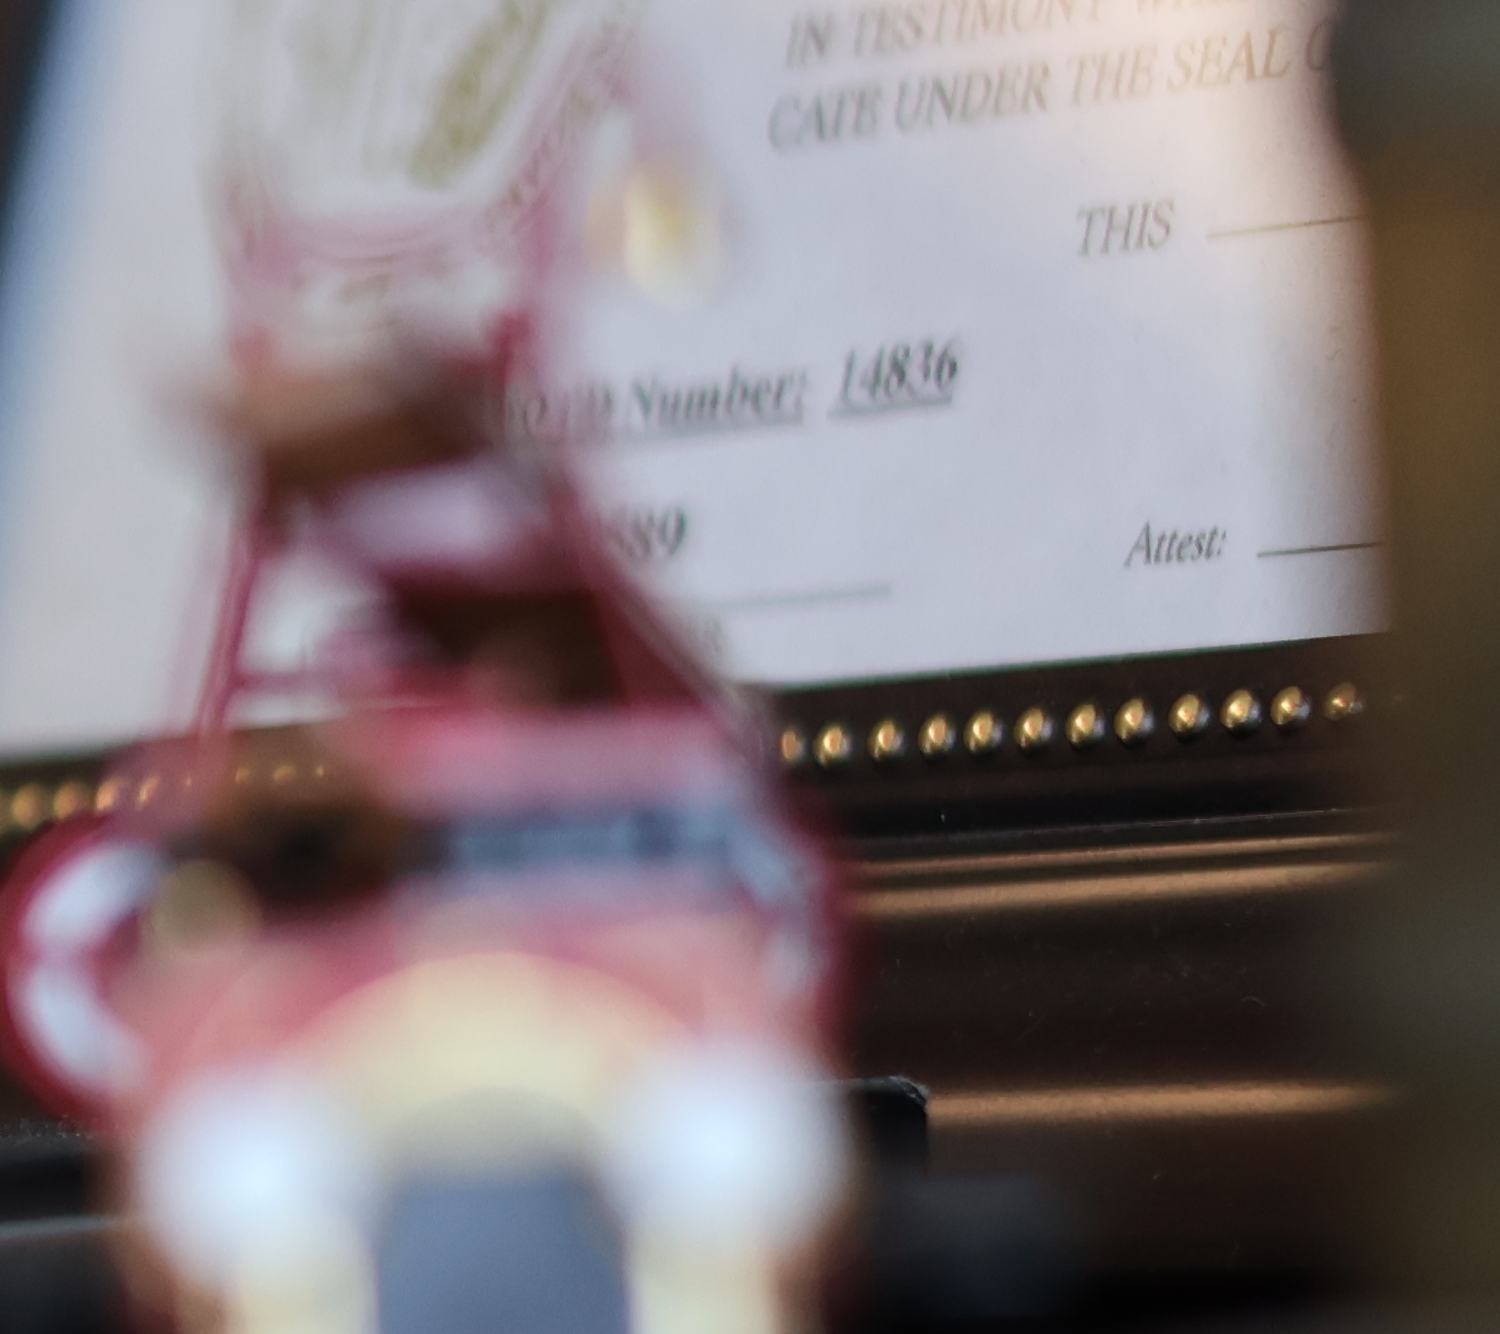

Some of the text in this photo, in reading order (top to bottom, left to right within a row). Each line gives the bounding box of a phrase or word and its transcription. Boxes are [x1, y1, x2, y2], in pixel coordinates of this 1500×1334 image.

[785, 13, 834, 66] IN
[768, 81, 884, 151] CATE
[896, 58, 1053, 133] UNDER
[1068, 43, 1158, 109] THE
[1168, 25, 1296, 93] SEAL
[1077, 198, 1177, 259] THIS
[838, 337, 962, 405] 14836
[1123, 519, 1227, 567] Attest:
